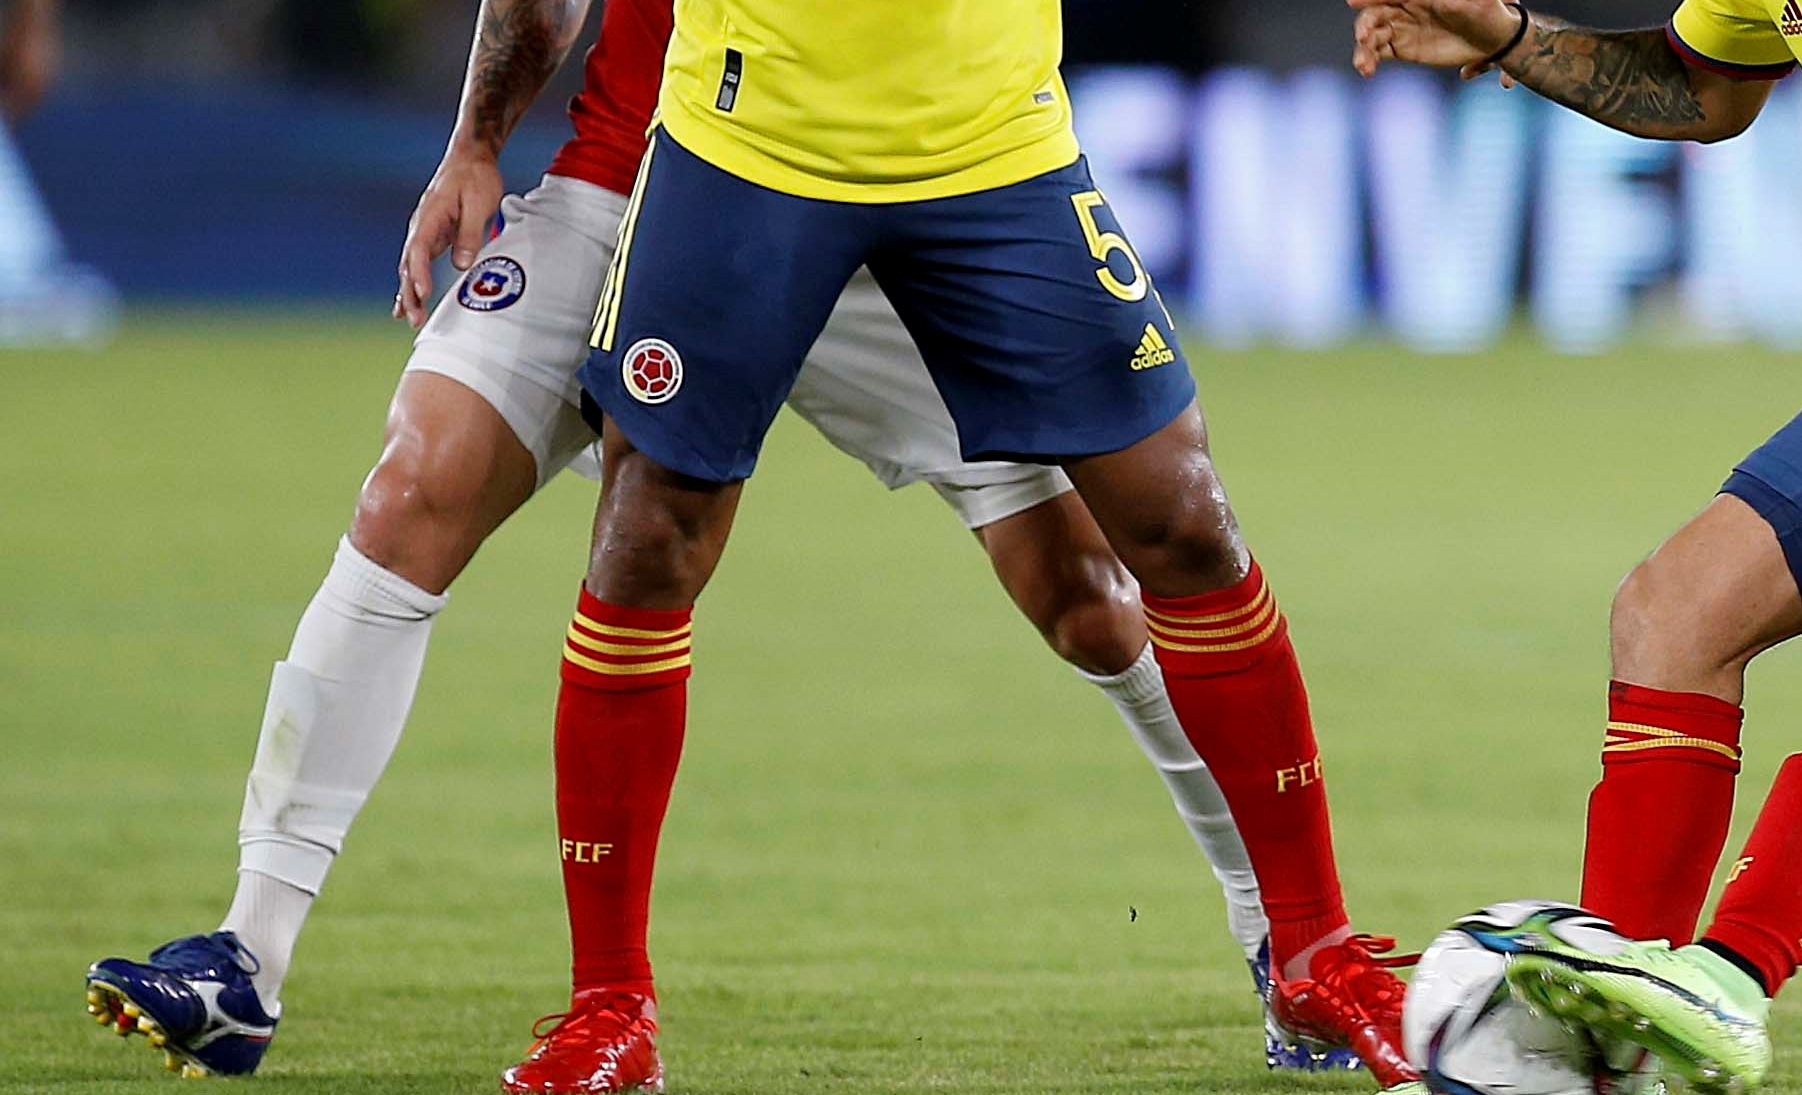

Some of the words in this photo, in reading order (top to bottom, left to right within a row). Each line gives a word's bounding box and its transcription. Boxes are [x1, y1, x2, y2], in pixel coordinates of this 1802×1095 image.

[1070, 190, 1149, 303] 5
[1130, 348, 1175, 372] adidas
[562, 837, 613, 864] FCF
